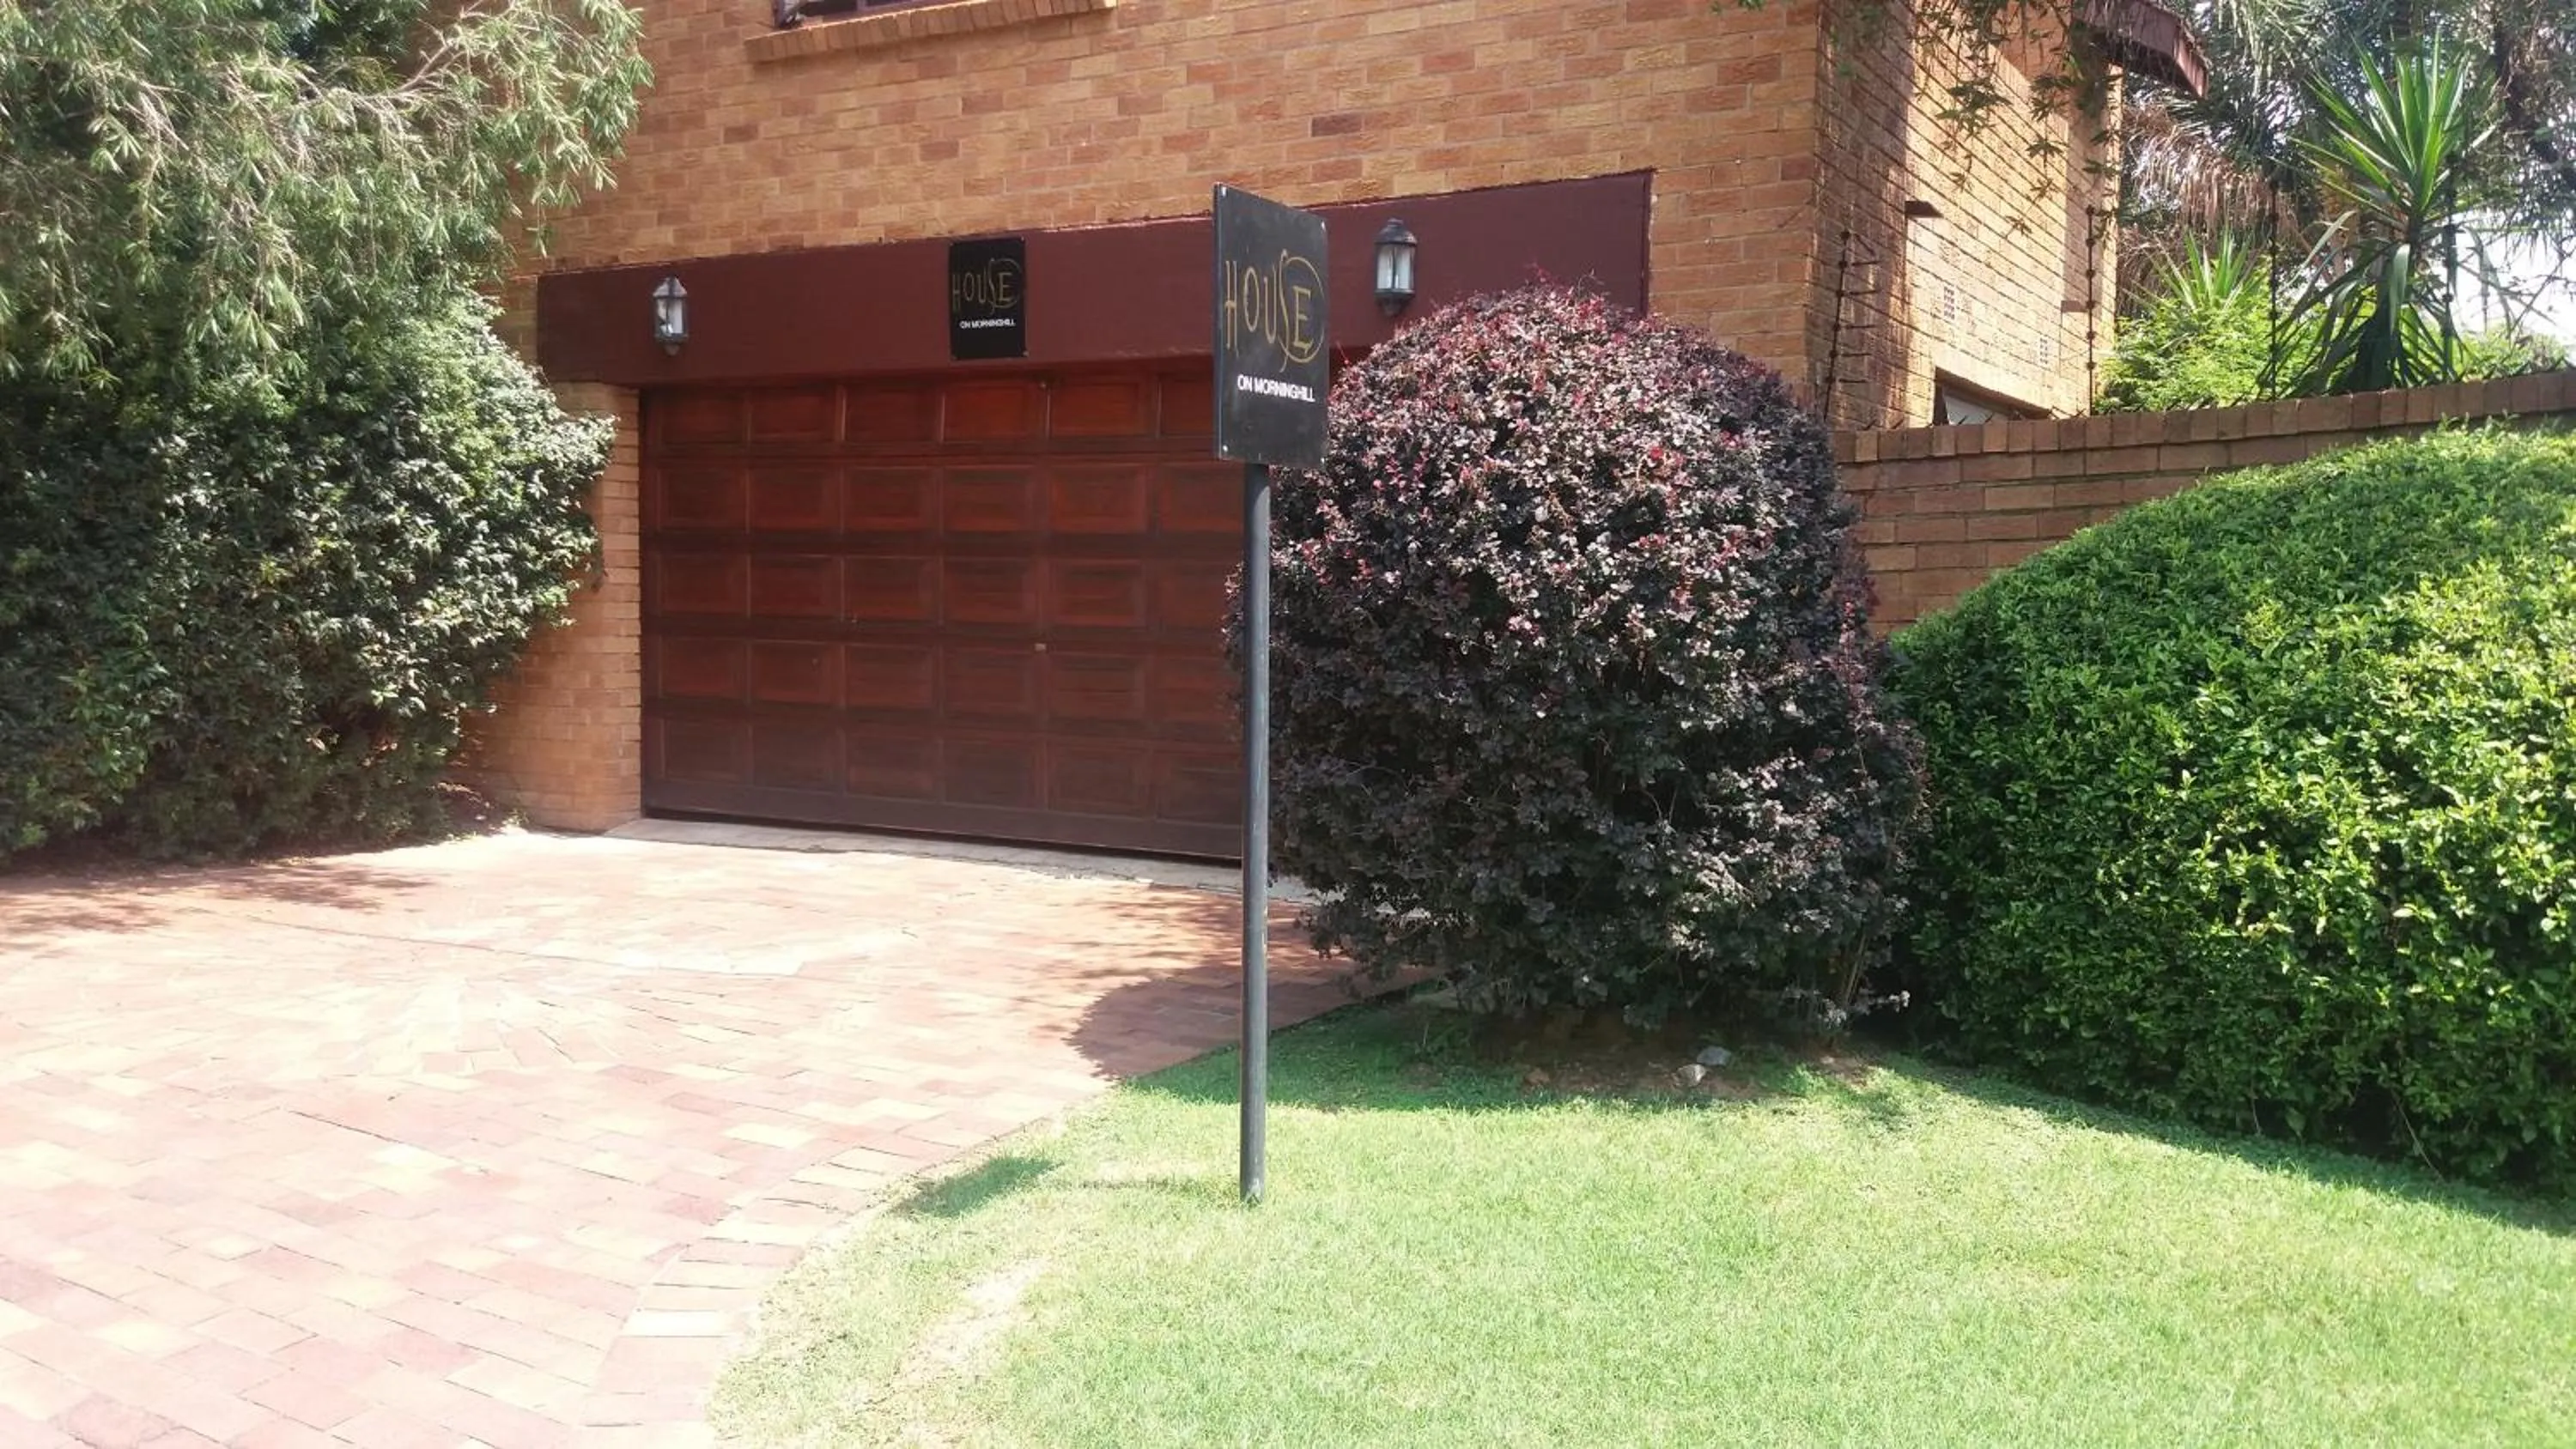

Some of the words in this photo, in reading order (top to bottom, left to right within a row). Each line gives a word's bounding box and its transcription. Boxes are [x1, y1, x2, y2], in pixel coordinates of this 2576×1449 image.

[952, 258, 1022, 315] HOUSE
[1225, 249, 1324, 373] HOUSE
[1237, 374, 1253, 391] ON
[1254, 377, 1315, 403] MORNINGHILL
